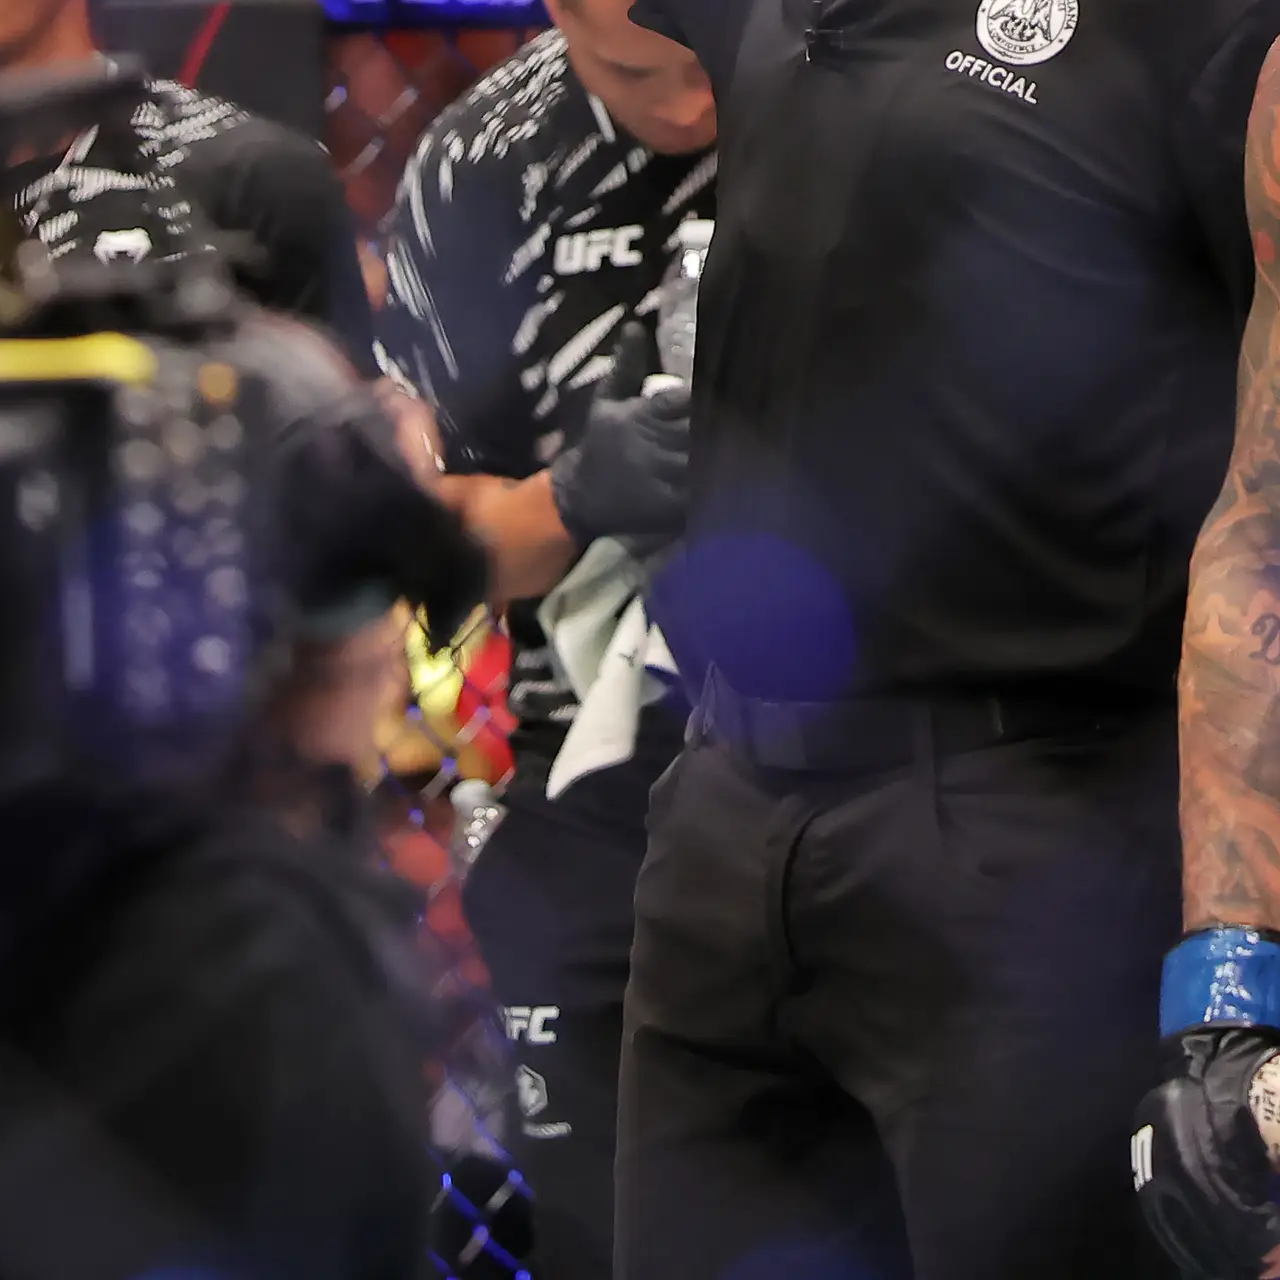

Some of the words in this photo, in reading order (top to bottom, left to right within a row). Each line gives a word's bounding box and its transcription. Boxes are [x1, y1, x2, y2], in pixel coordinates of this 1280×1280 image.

[945, 51, 1038, 105] OFFICIAL
[553, 224, 645, 276] UFC
[504, 1005, 561, 1045] FC
